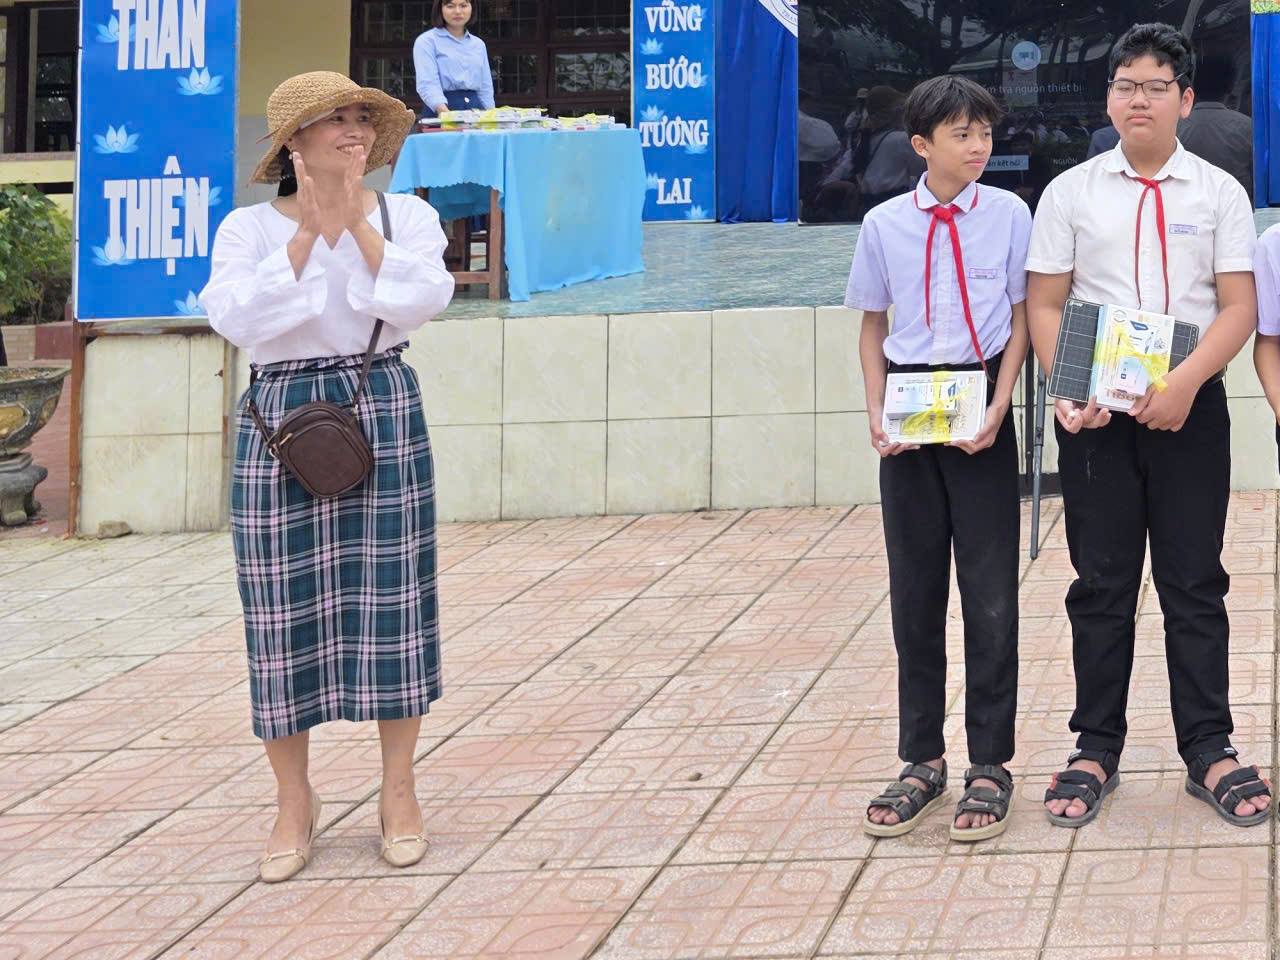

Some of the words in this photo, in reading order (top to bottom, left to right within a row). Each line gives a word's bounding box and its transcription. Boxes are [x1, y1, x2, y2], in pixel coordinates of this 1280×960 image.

[644, 0, 703, 32] VỮNG
[645, 55, 702, 90] BƯỚC
[999, 86, 1013, 94] tra
[1048, 82, 1071, 93] thiết
[639, 115, 710, 147] TƯƠNG
[656, 177, 693, 205] LAI
[104, 156, 209, 276] THIỆN
